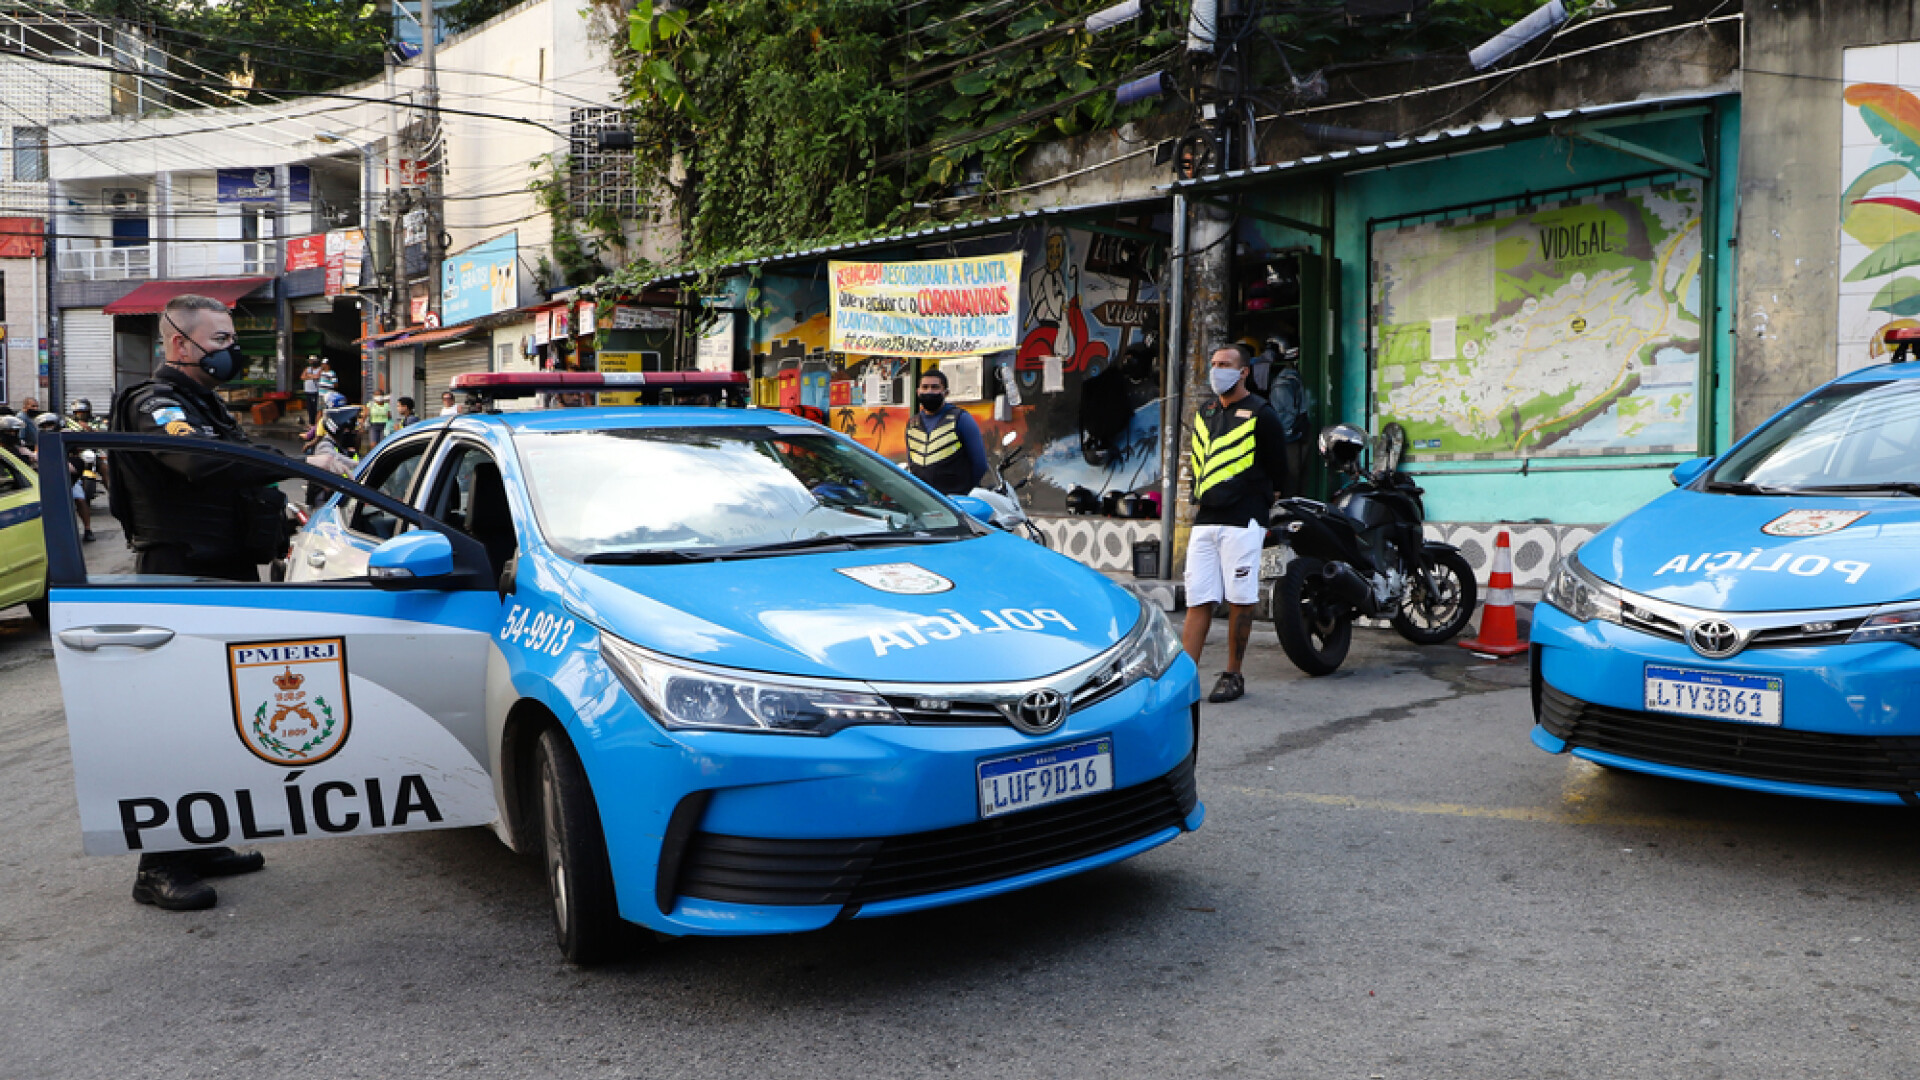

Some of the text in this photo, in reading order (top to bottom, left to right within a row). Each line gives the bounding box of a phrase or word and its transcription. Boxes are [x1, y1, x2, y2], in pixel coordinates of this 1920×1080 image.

[1540, 220, 1614, 261] VIDIGAL
[963, 260, 1008, 285] PLANTA
[500, 604, 575, 657] 54-9913
[238, 644, 335, 663] PMERJ
[1657, 682, 1763, 717] LTY3B61
[993, 759, 1097, 808] LUF9D16
[118, 769, 443, 850] POLÍCIA
